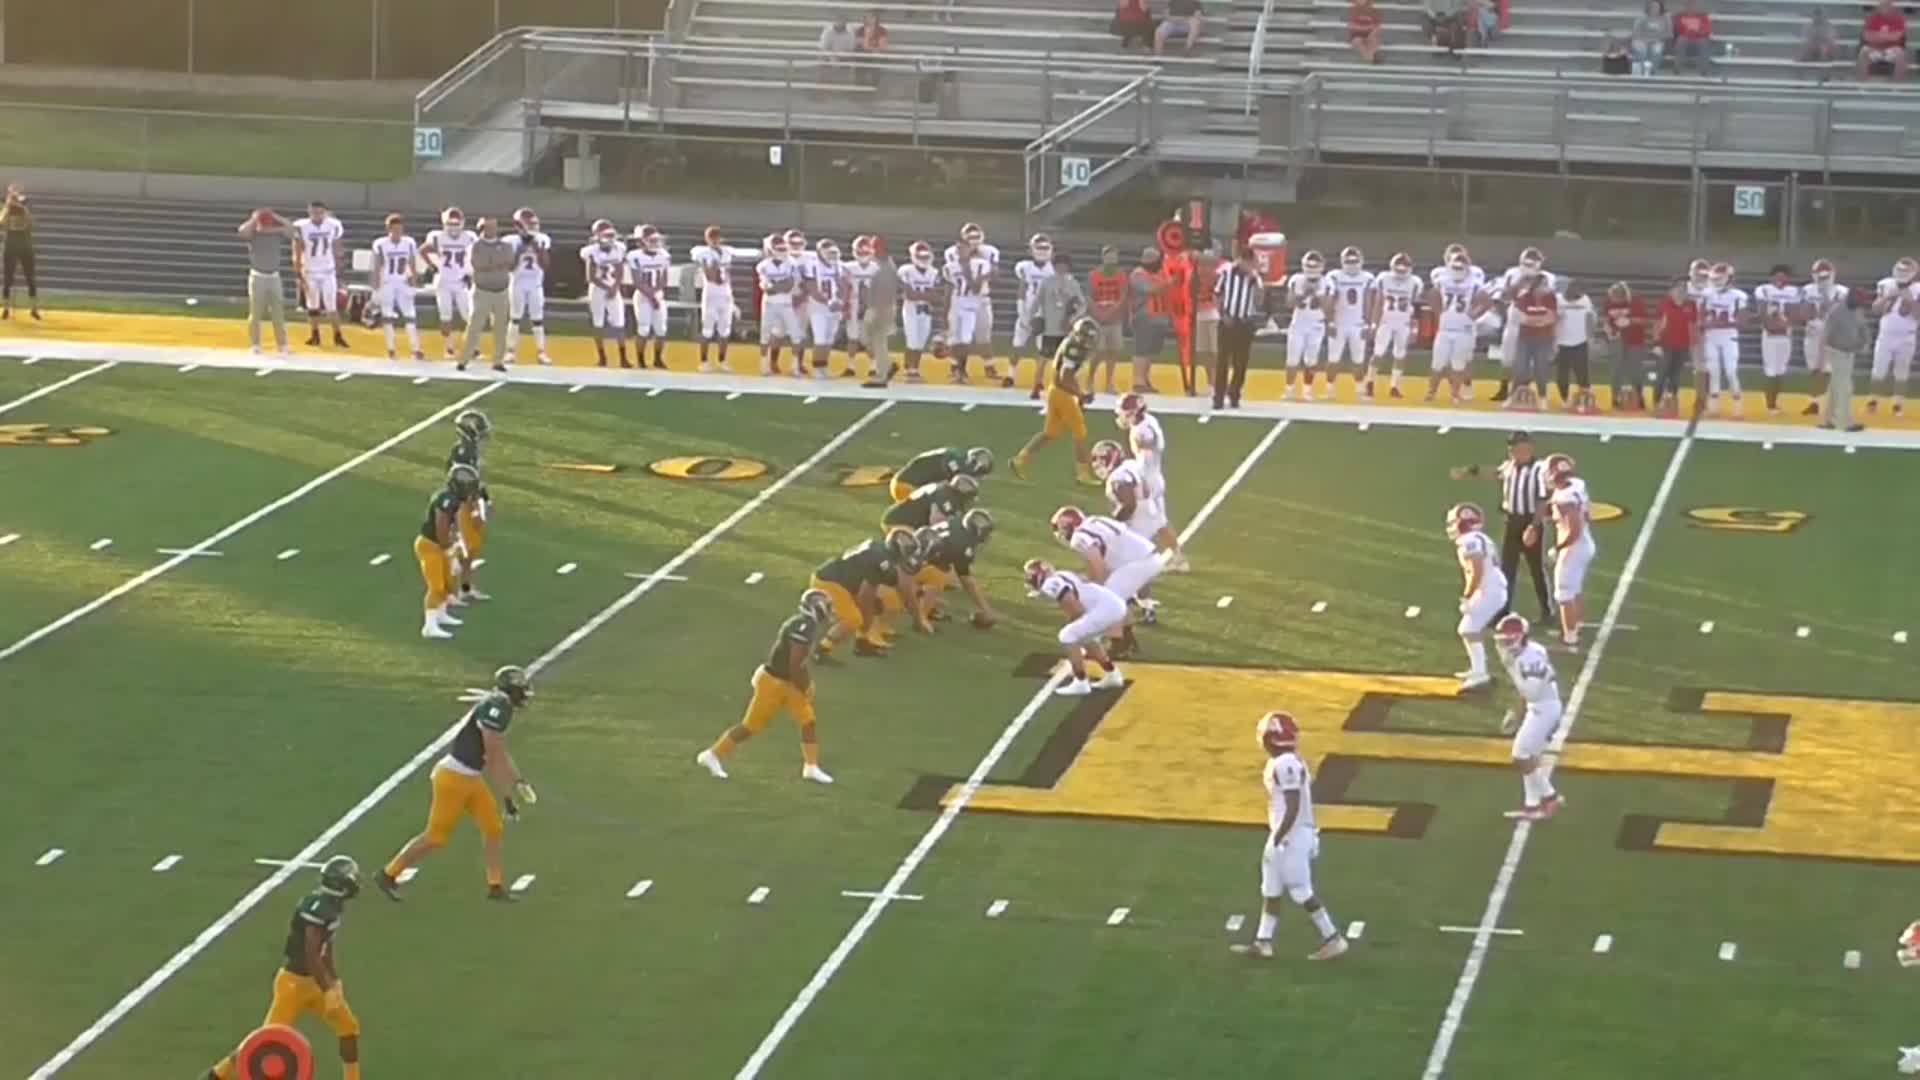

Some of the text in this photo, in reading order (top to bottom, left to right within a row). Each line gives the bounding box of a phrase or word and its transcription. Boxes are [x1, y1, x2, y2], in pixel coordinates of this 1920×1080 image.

[415, 131, 441, 153] 30
[1063, 162, 1089, 181] 40
[1737, 190, 1762, 210] 50
